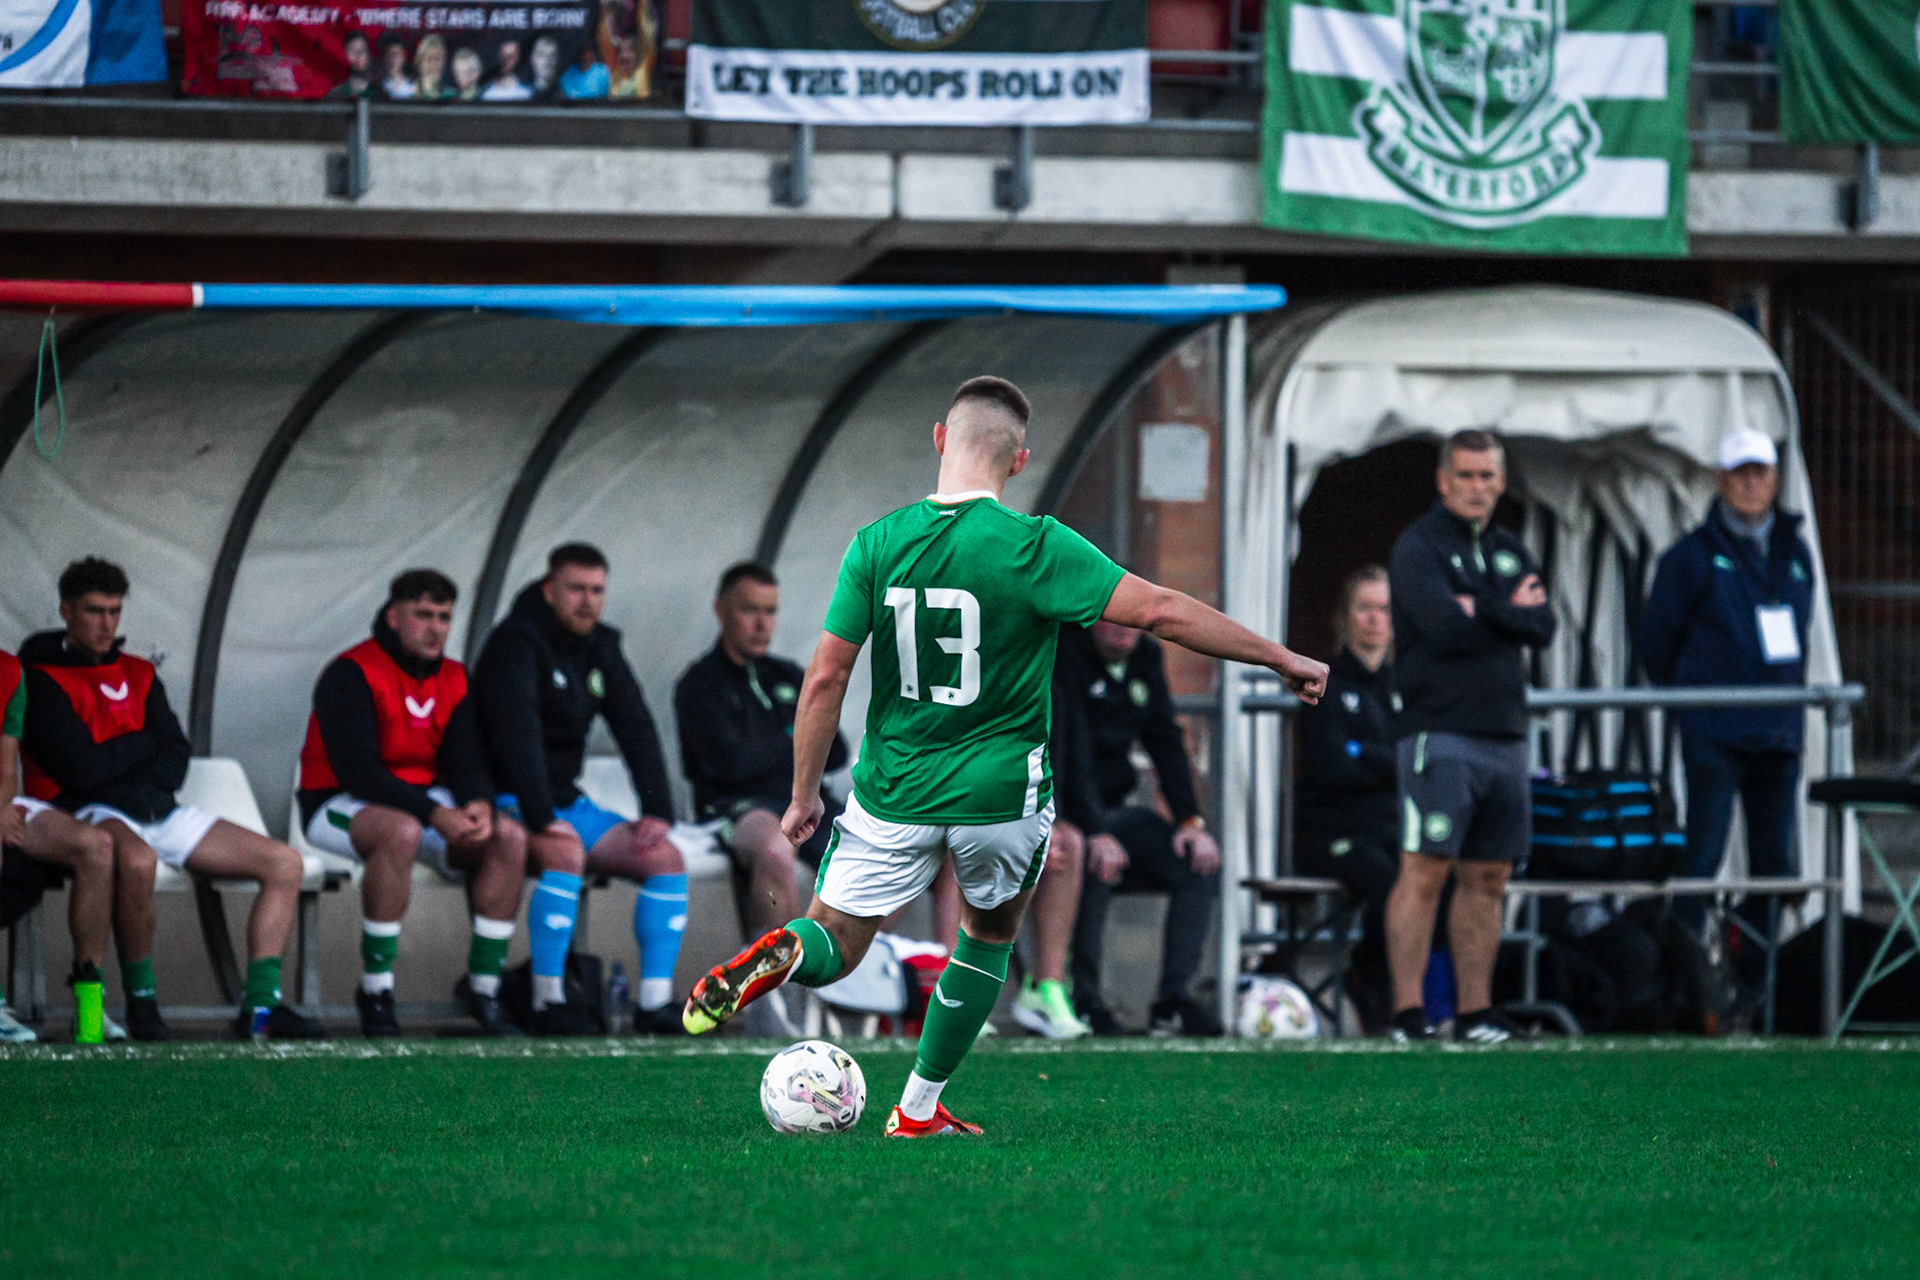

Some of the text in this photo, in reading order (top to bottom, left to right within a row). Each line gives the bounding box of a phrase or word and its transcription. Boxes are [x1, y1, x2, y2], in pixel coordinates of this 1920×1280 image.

[713, 64, 769, 94] LET
[785, 67, 846, 95] THE
[857, 68, 965, 97] HOOPS
[1073, 68, 1122, 96] ON
[883, 586, 980, 707] 13
